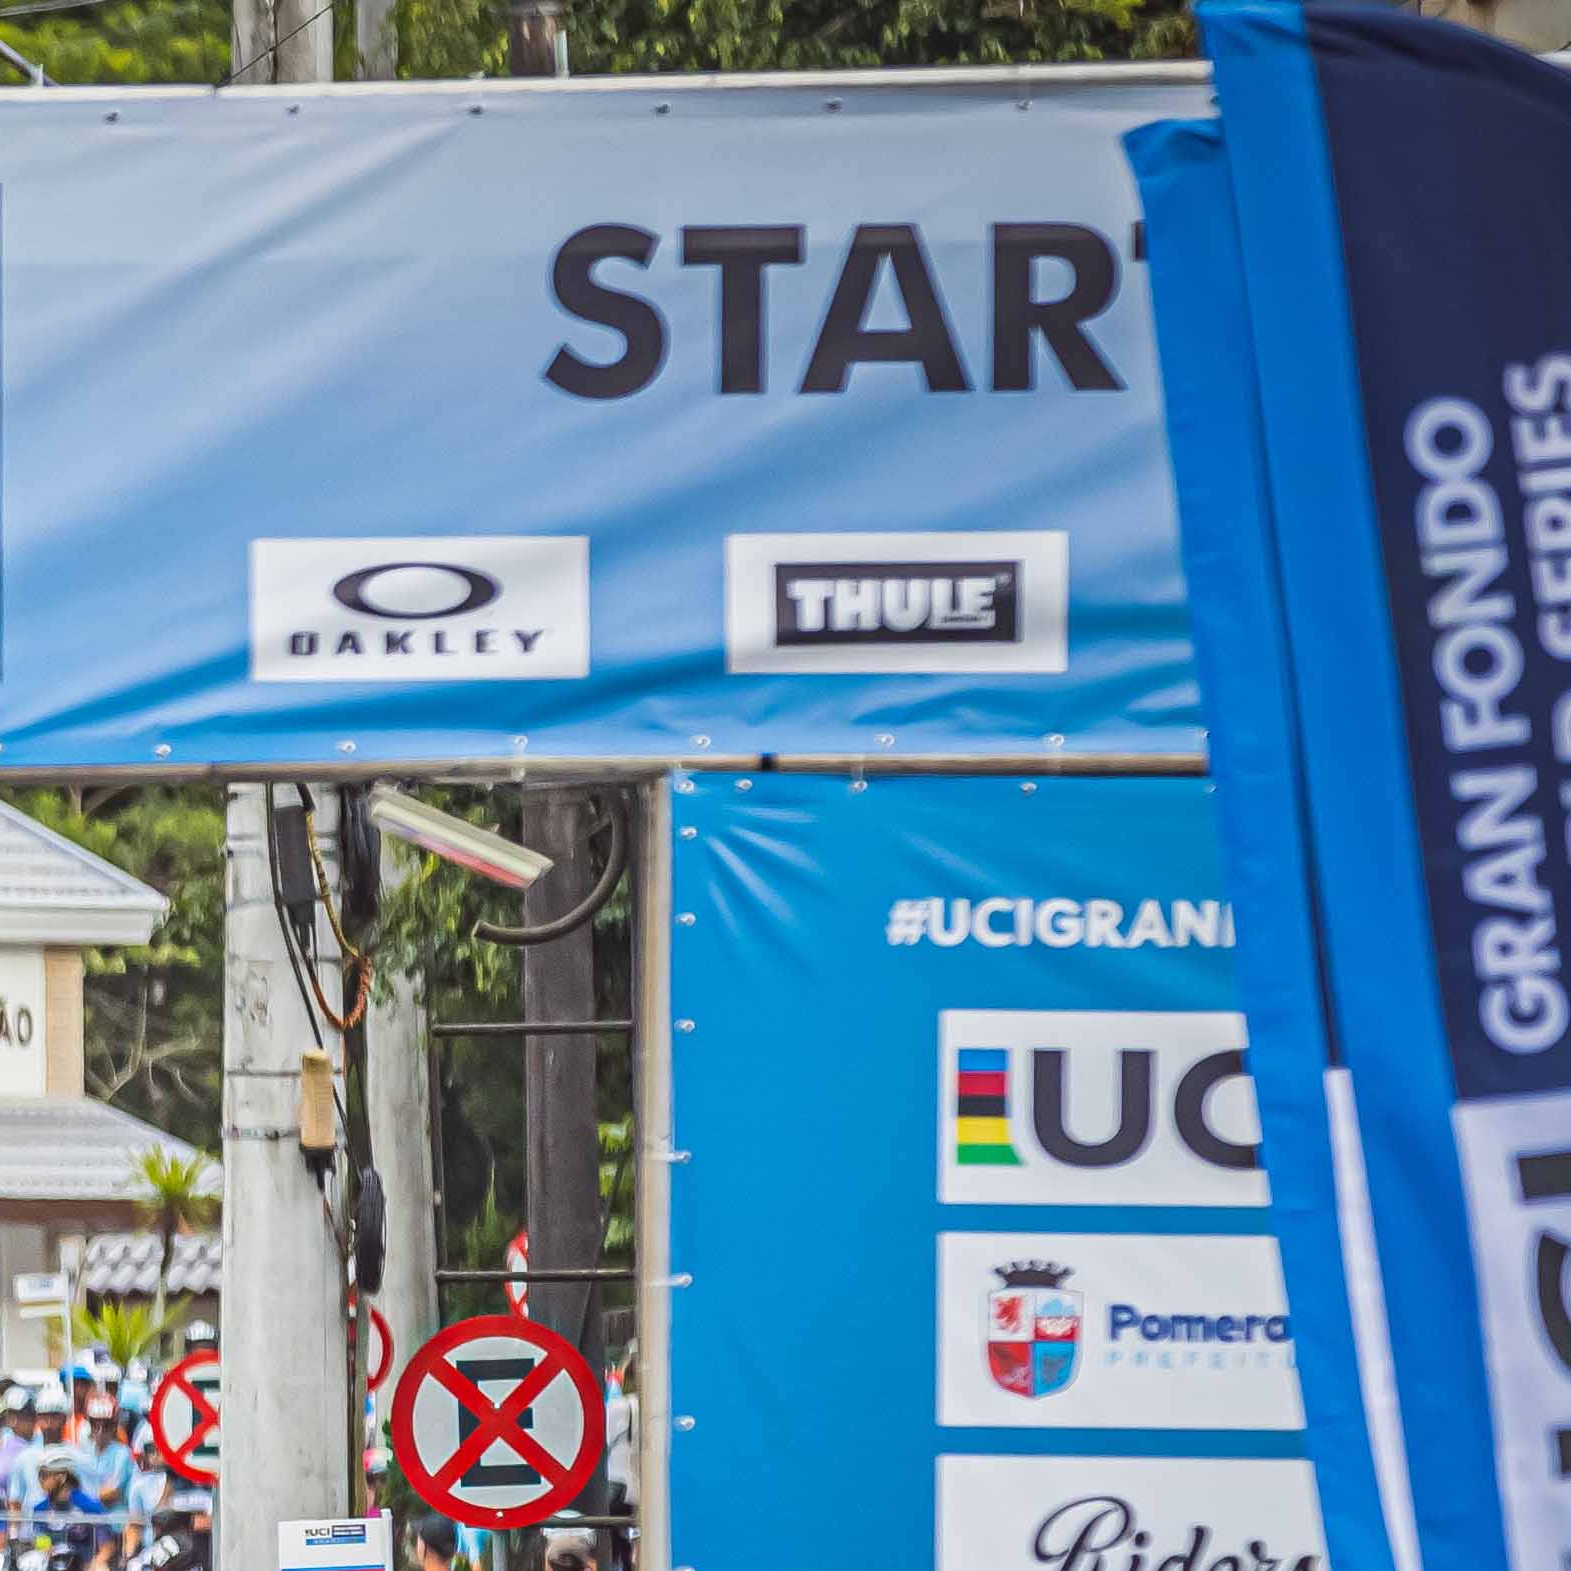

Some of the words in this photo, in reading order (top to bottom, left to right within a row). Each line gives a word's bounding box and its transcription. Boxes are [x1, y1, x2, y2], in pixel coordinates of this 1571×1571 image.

[545, 221, 1148, 400] STAR
[786, 576, 998, 632] THULE
[1403, 396, 1533, 753] FONDO
[287, 630, 543, 657] OAKLEY
